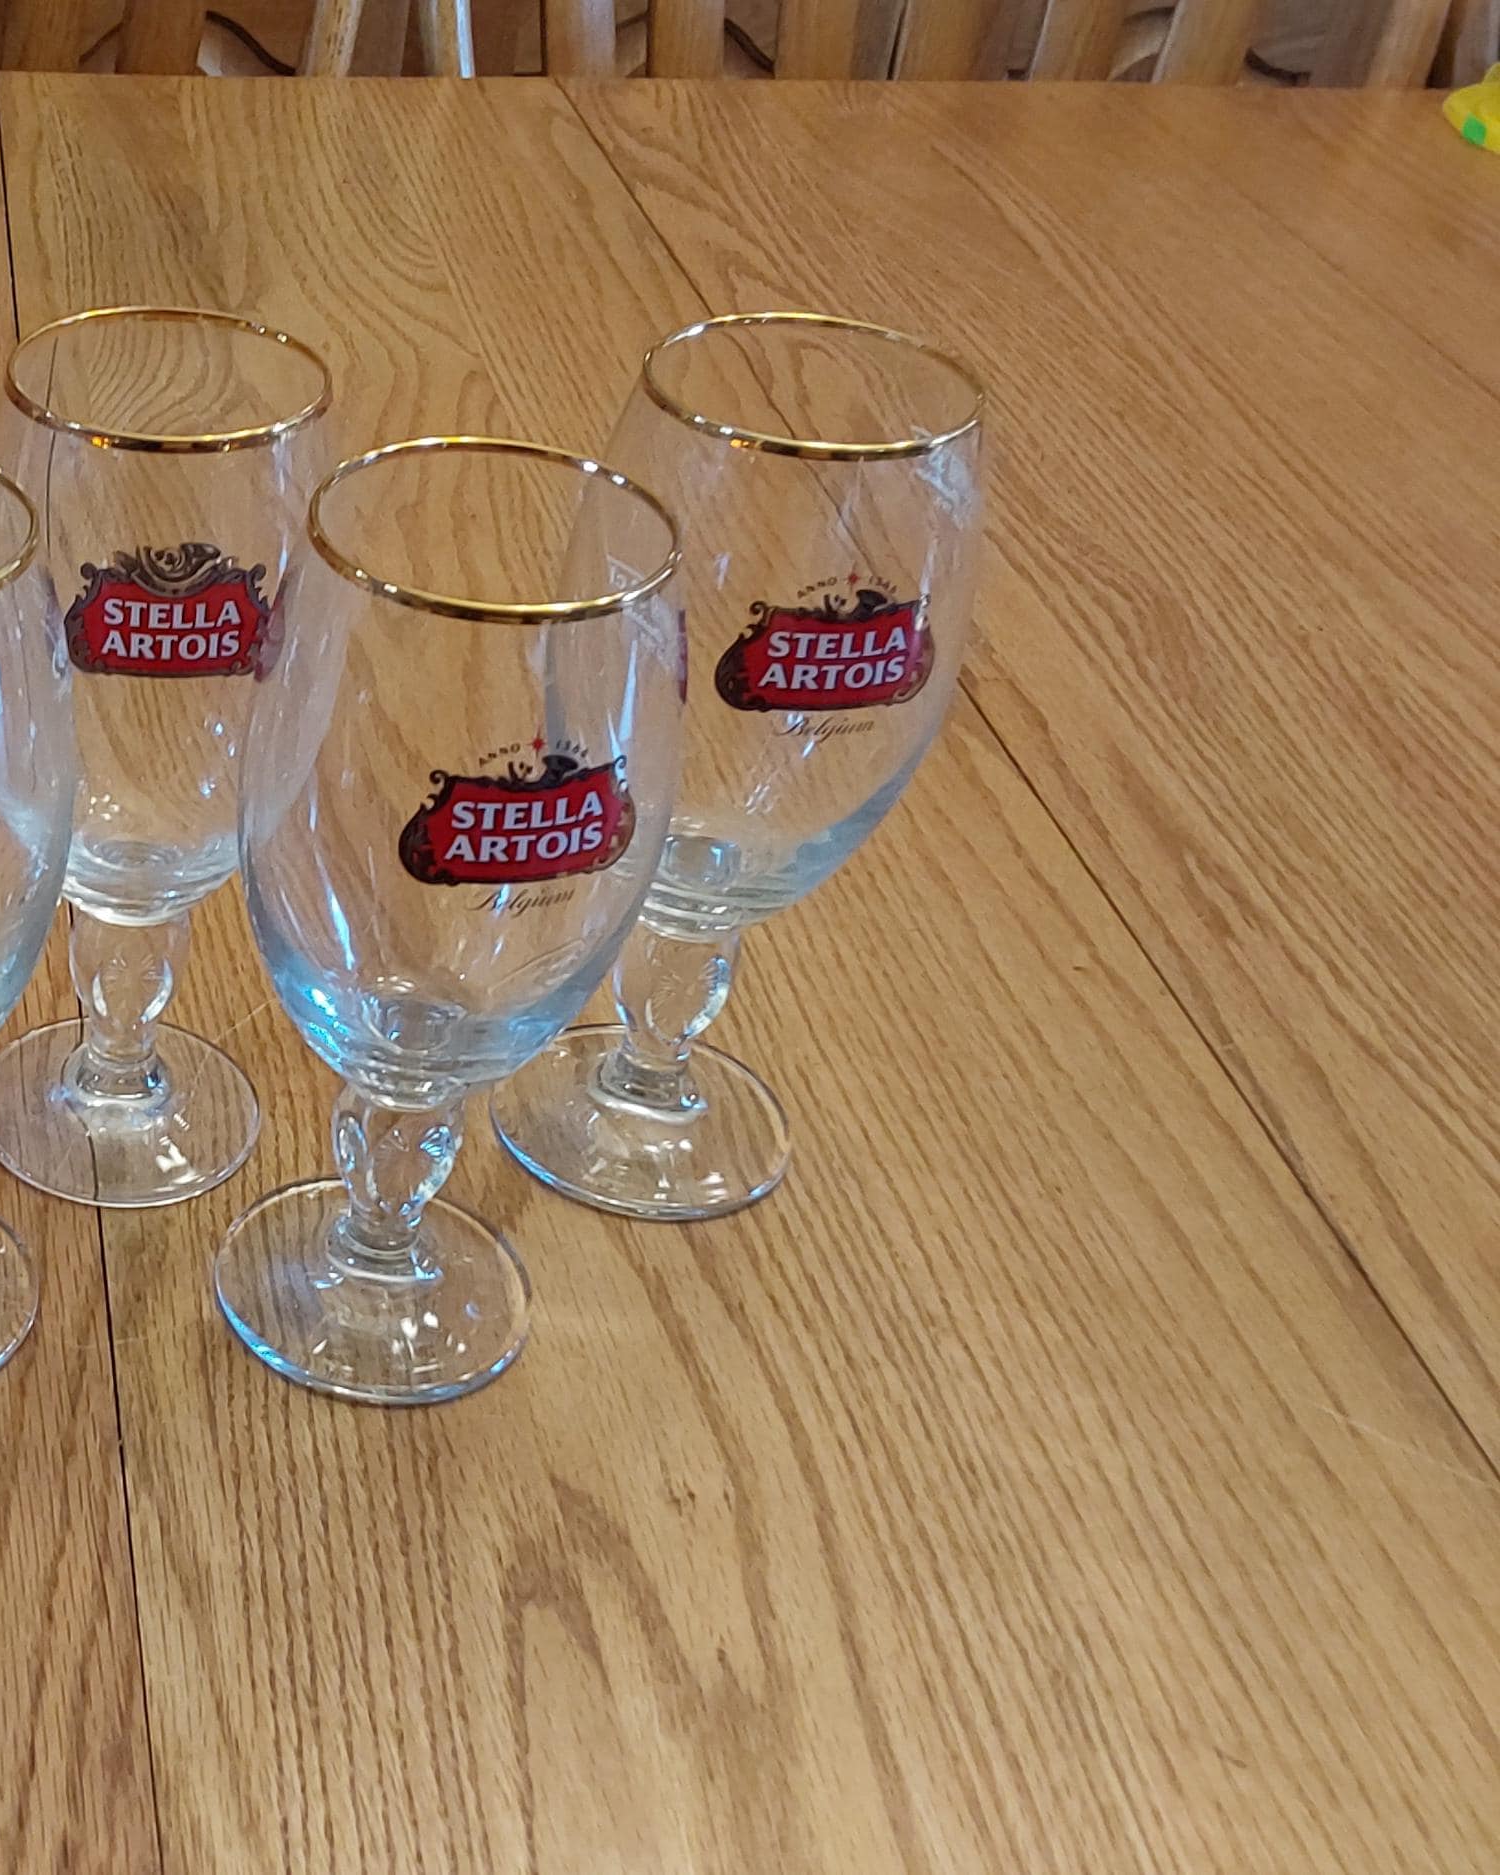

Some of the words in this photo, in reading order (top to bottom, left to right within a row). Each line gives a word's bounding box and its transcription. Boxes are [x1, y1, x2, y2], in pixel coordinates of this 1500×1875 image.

[103, 598, 241, 629] STELLA
[101, 630, 240, 660] ARTOIS
[767, 626, 907, 659] STELLA
[758, 656, 905, 690] ARTOIS
[772, 716, 875, 743] Belgium
[451, 790, 603, 830] STELLA
[443, 821, 603, 863] ARTOIS
